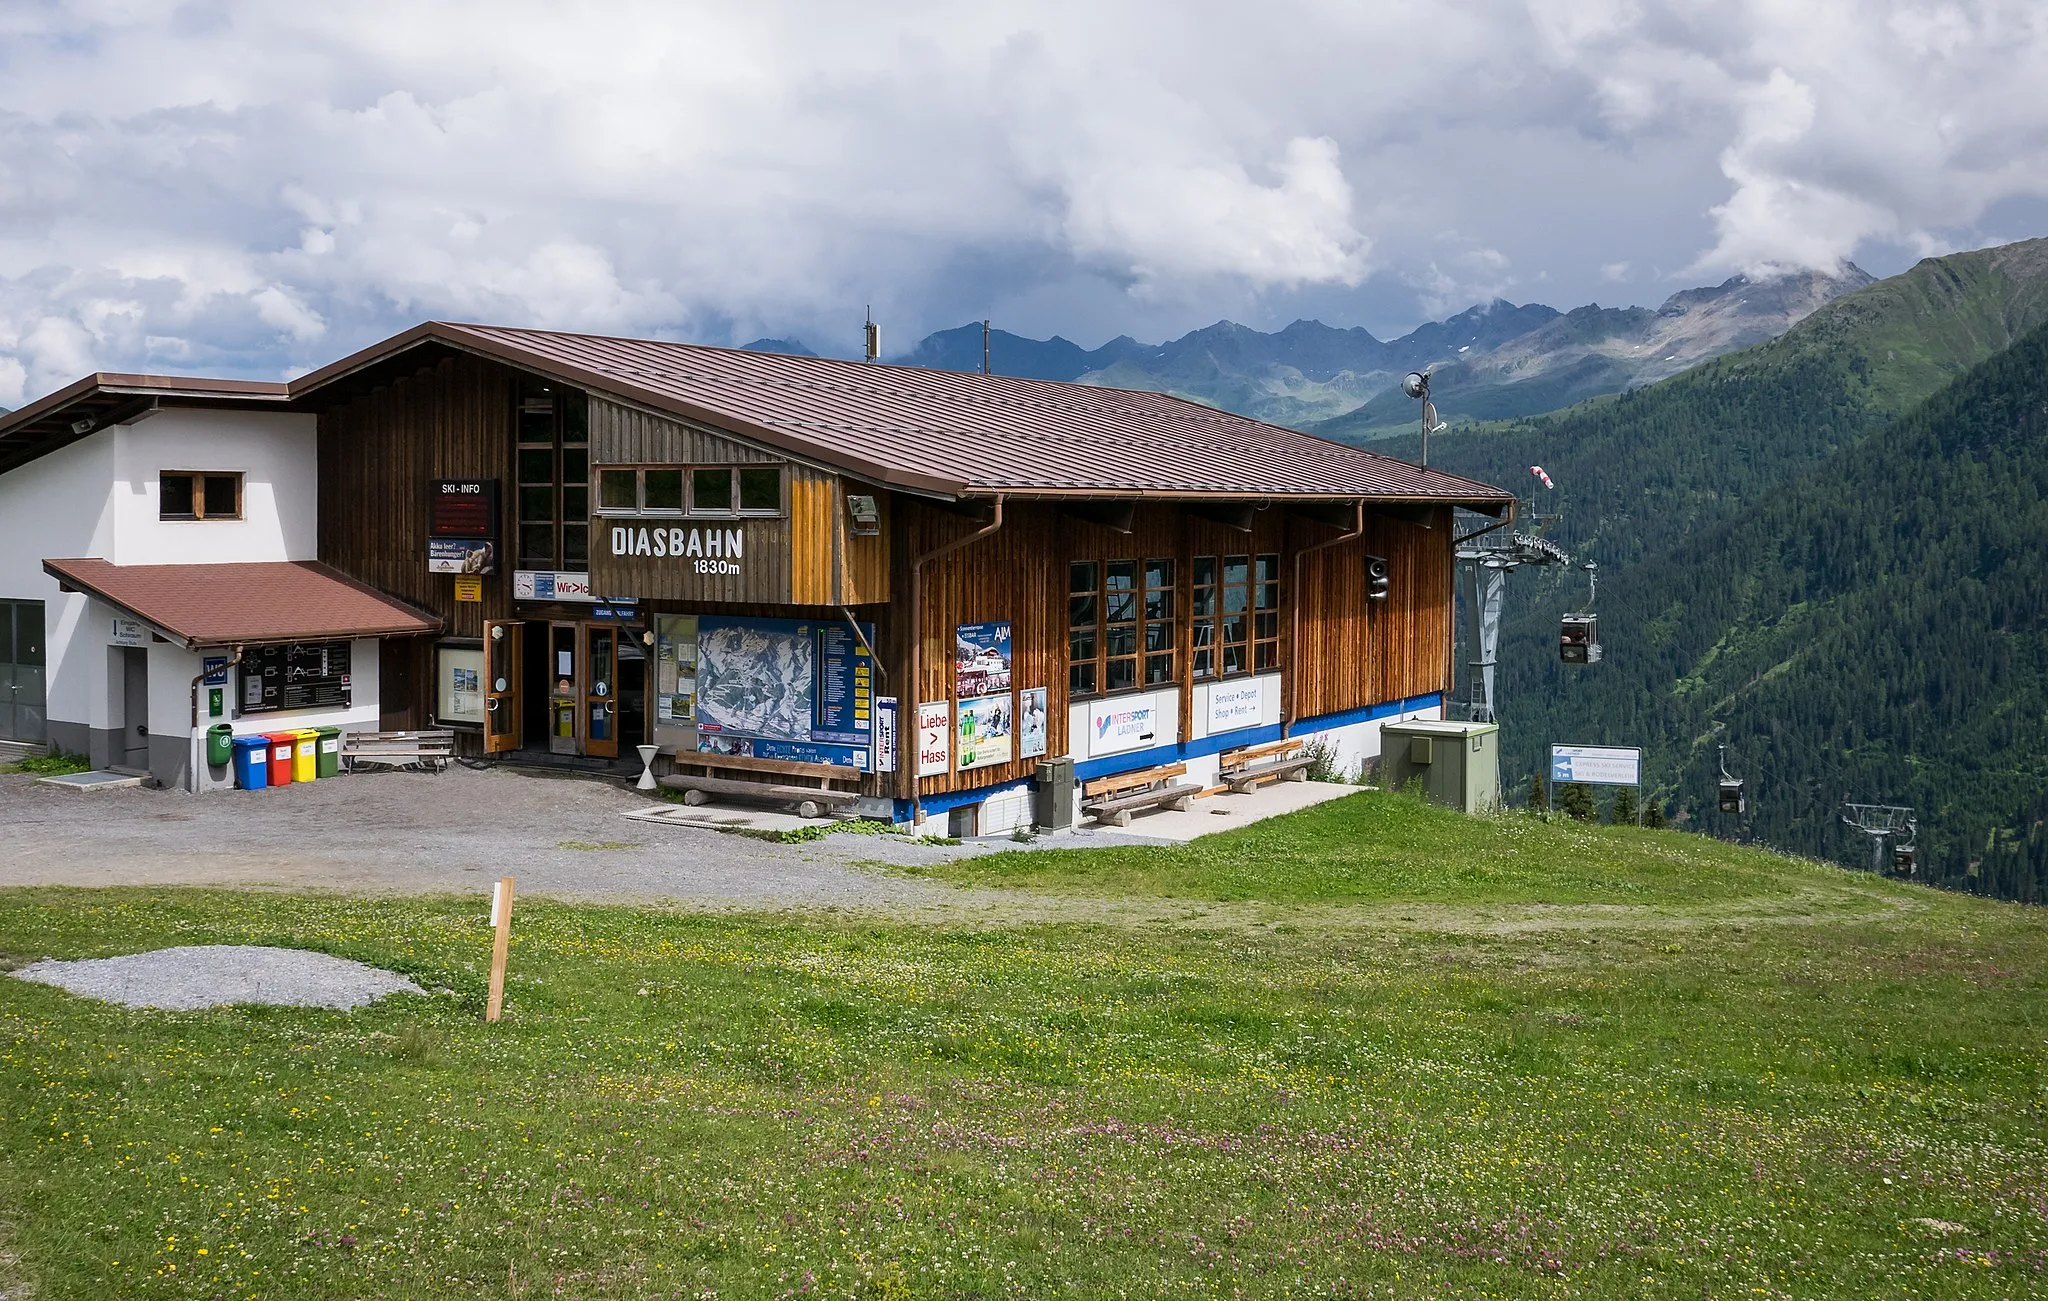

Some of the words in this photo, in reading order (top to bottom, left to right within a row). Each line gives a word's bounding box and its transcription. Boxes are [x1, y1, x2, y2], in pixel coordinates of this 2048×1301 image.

[442, 484, 456, 494] SKI
[461, 484, 480, 494] INFO
[612, 527, 743, 559] DIASBAHN
[693, 560, 740, 575] 1830m
[206, 663, 224, 677] WC
[1216, 693, 1235, 704] Service
[1241, 689, 1256, 701] Depot
[1112, 709, 1150, 725] INTERSPORT
[1215, 709, 1229, 719] Shop
[1235, 705, 1247, 716] Rent
[920, 713, 947, 729] Liebe
[1117, 722, 1145, 736] LADNER
[921, 750, 946, 764] Hass
